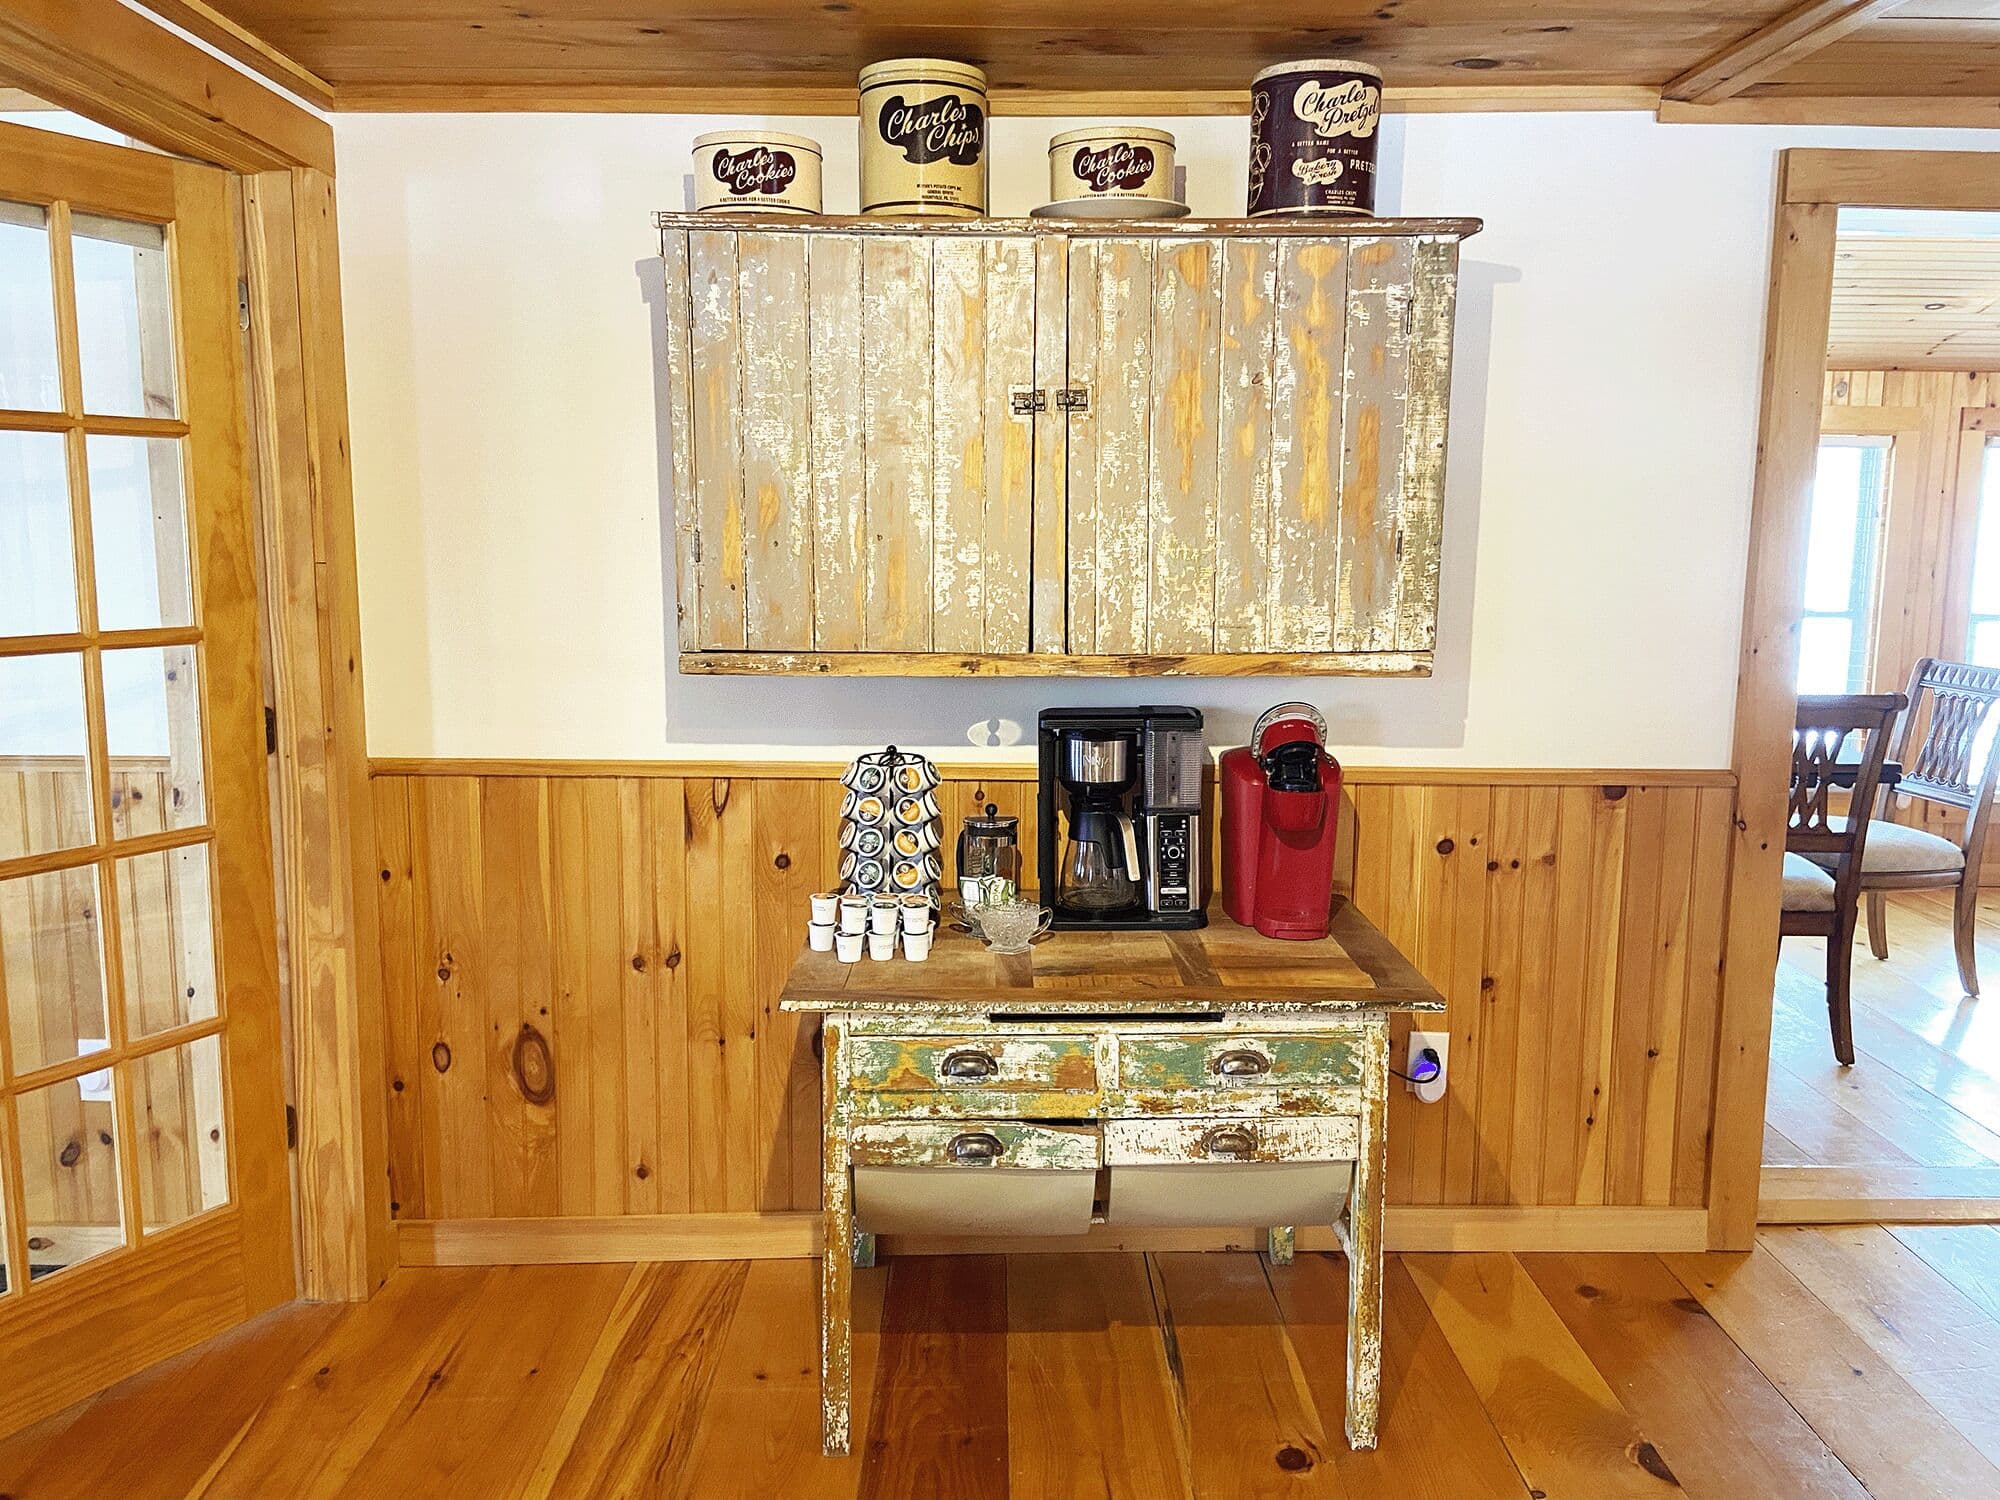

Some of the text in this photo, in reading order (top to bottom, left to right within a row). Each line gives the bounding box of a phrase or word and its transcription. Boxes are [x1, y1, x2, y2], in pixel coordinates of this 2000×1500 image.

[1302, 84, 1366, 116] Charles
[1320, 96, 1378, 133] Pretzel
[888, 100, 966, 139] Charles
[926, 123, 978, 155] Chips
[718, 149, 774, 179] Charles
[736, 164, 793, 190] Cookies
[1079, 146, 1135, 177] Charles
[1096, 159, 1152, 186] Cookies
